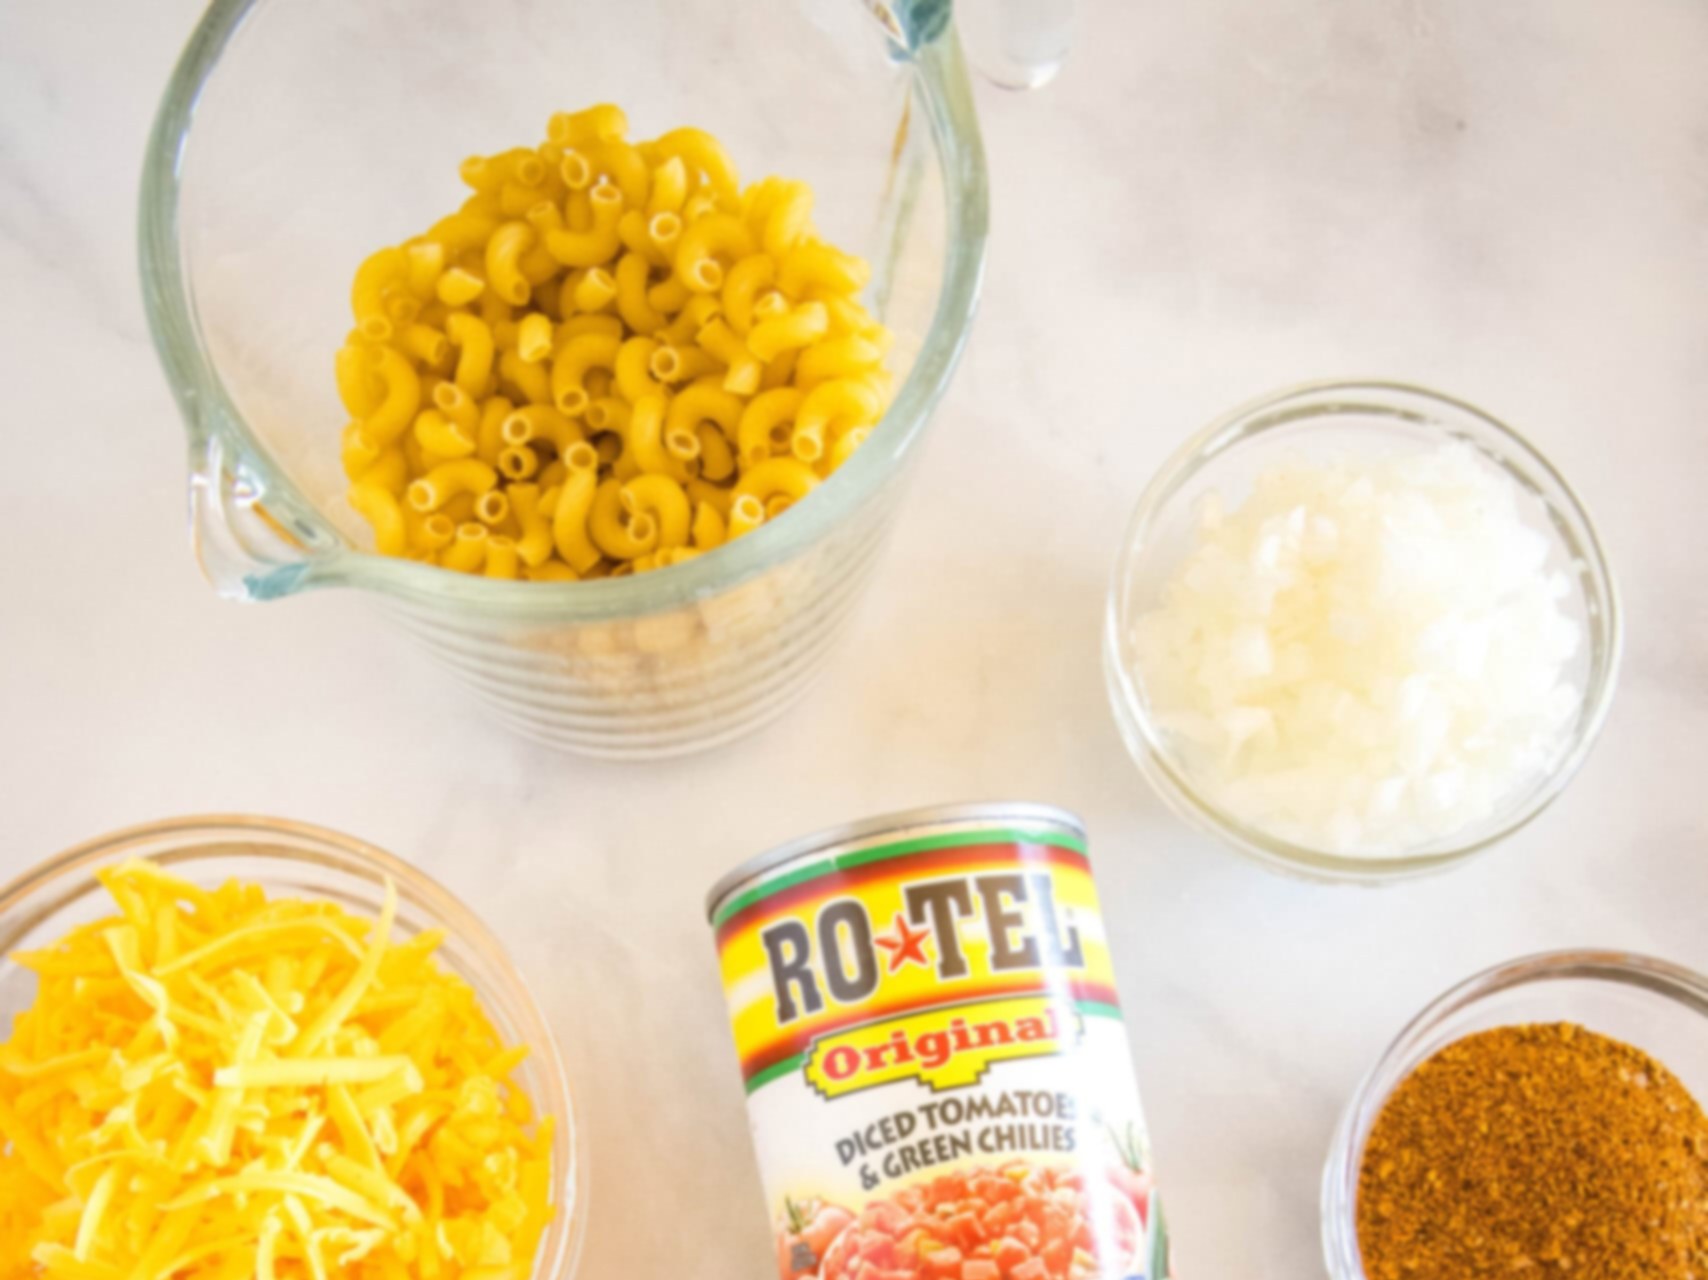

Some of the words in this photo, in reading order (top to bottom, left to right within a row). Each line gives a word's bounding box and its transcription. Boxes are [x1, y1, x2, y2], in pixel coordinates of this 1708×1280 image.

[822, 1008, 1058, 1081] Original
[835, 1111, 917, 1166] DICED
[859, 1163, 880, 1191] &
[882, 1130, 973, 1178] GREEN
[977, 1124, 1077, 1153] CHILIES
